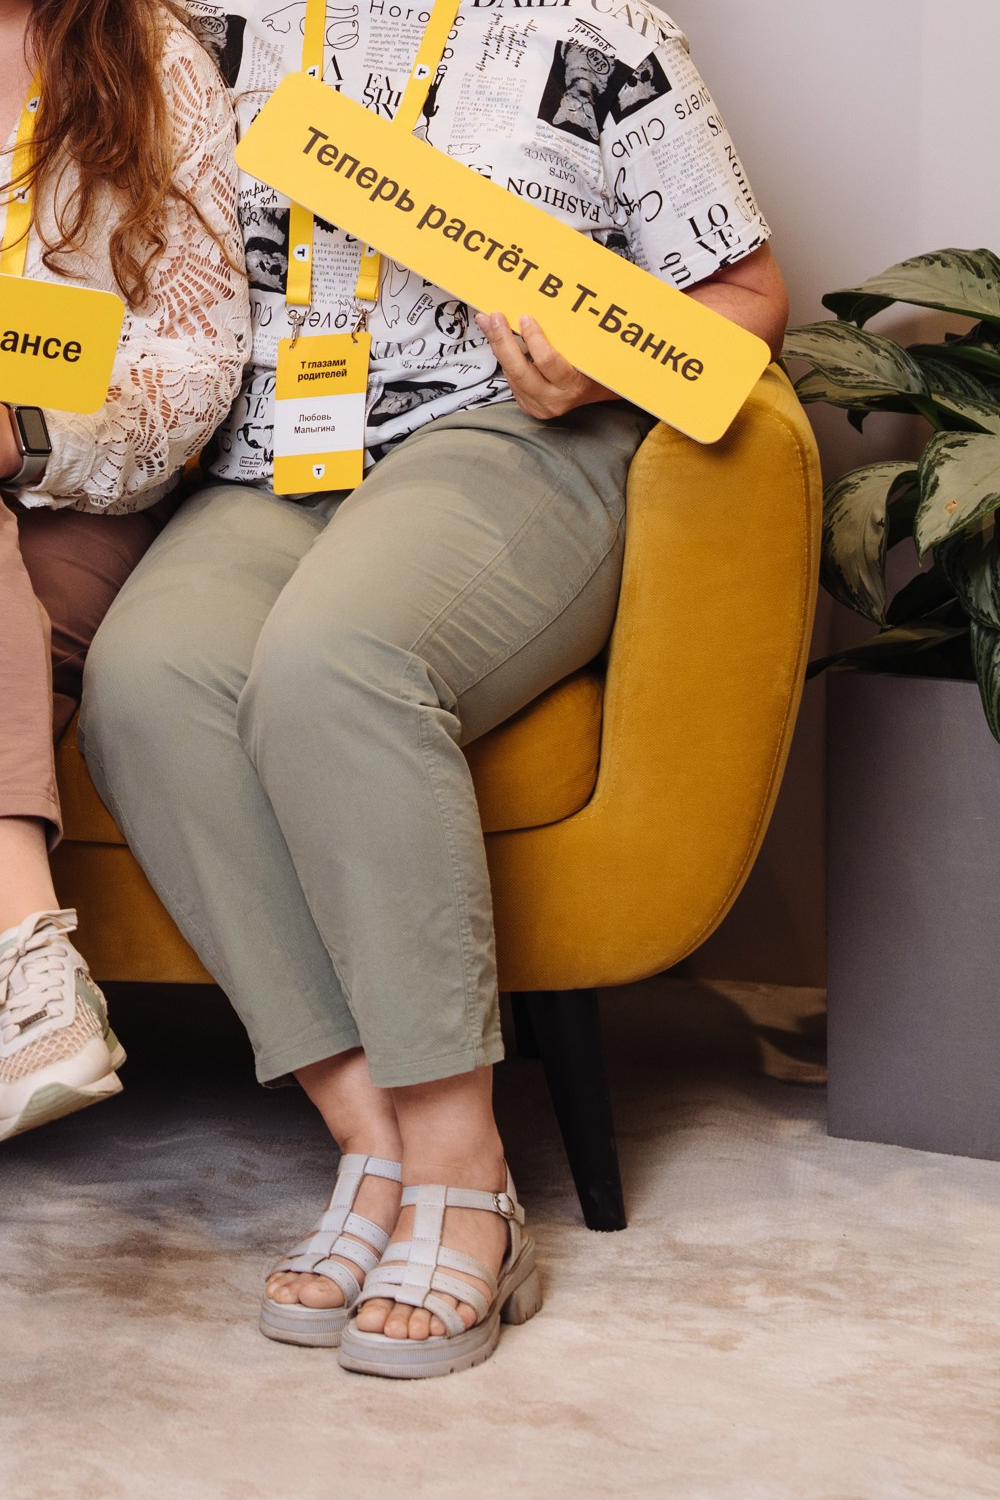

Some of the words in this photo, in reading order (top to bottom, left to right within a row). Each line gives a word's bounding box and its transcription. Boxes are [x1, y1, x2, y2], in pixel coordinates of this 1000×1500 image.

[203, 17, 221, 32] Stay
[568, 24, 610, 51] yourself
[589, 50, 606, 71] Stay
[612, 118, 664, 158] Club
[507, 177, 602, 224] FASHION
[687, 203, 729, 240] LO
[696, 223, 742, 257] VE
[302, 126, 415, 214] Теперь
[417, 203, 539, 281] растёт
[539, 273, 564, 298] в
[572, 283, 704, 382] Т-Банке
[297, 368, 348, 382] родителей
[307, 359, 346, 369] глазами
[294, 425, 336, 434] Малыгина
[299, 414, 332, 423] Любовь
